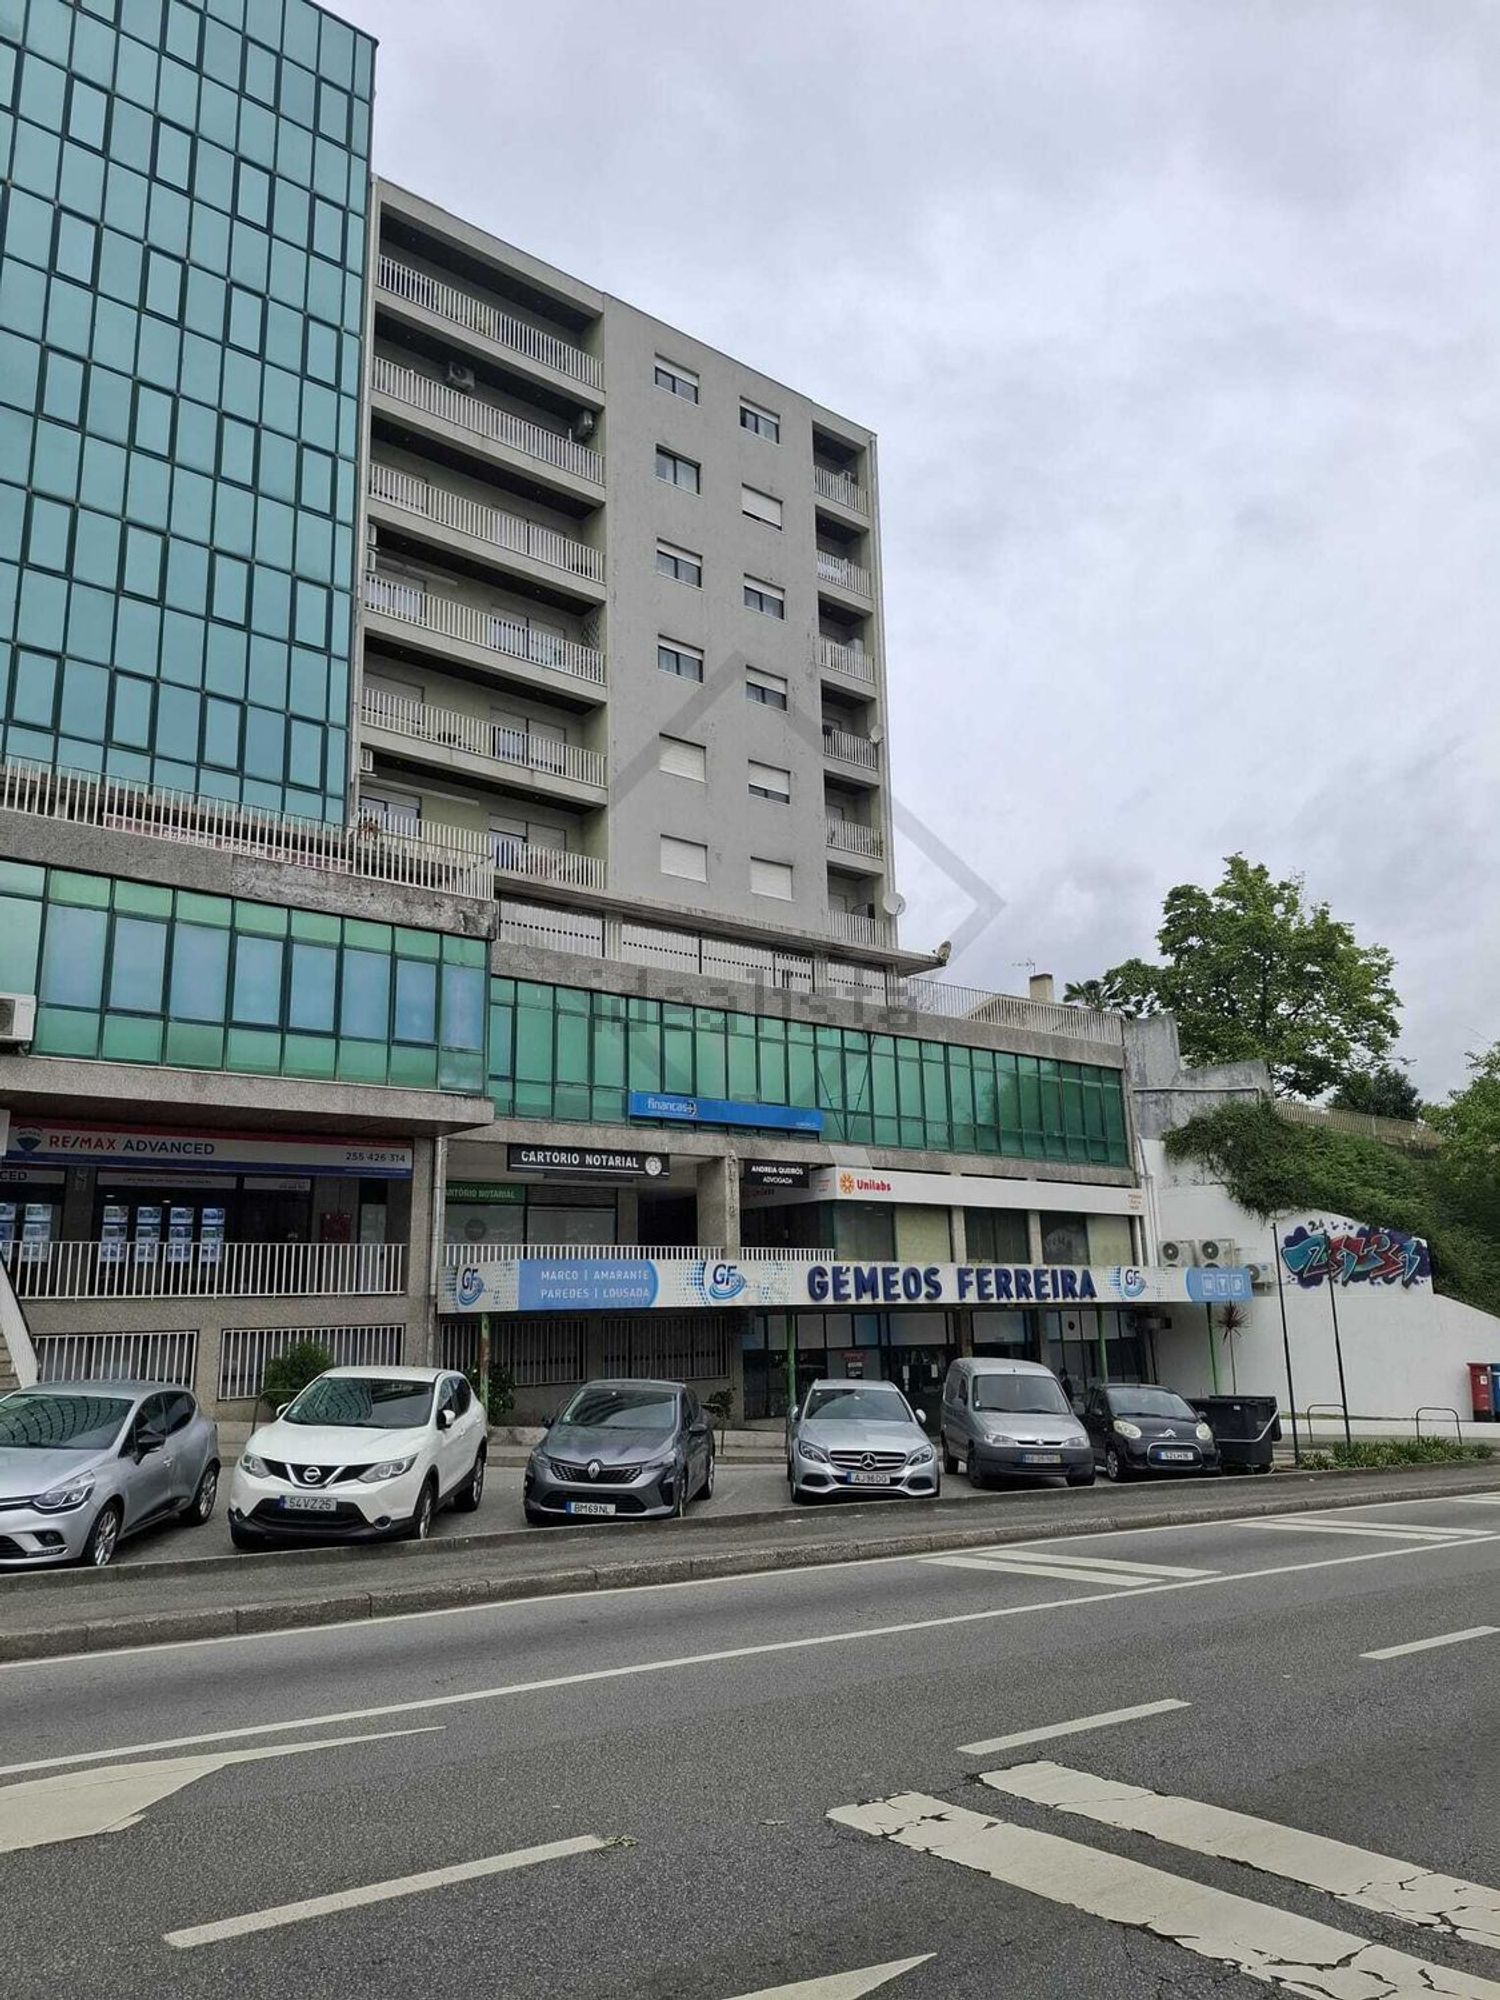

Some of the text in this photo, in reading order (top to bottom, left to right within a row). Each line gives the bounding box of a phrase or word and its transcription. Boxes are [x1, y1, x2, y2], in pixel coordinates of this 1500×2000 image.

[49, 1135, 215, 1155] RE/MAX ADVANCED
[585, 1153, 639, 1168] NOTARIAL
[750, 1164, 777, 1174] ANDREIA
[762, 1175, 793, 1185] ADVOGADA
[857, 1179, 892, 1192] Unilabs
[541, 1269, 649, 1280] MARCO AMARANTE
[712, 1263, 738, 1287] GF
[807, 1265, 1098, 1302] GÉMEOS FERREIRA
[541, 1287, 650, 1299] PAREDES LOUSADA
